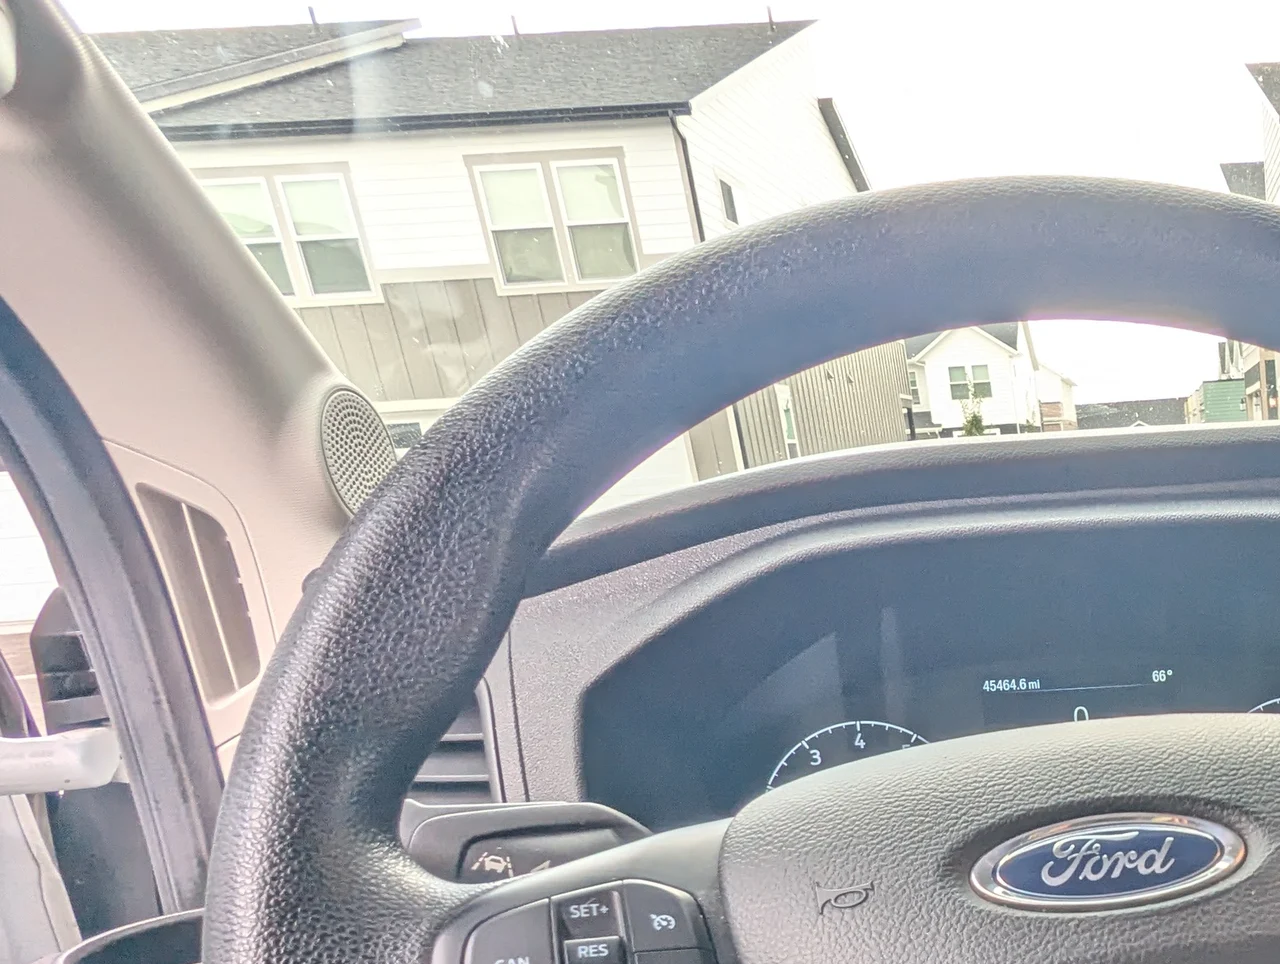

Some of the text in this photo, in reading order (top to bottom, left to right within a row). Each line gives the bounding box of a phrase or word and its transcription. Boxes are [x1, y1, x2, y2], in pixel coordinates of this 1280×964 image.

[982, 678, 1041, 692] 45464.6 mi
[854, 733, 866, 749] 4
[810, 750, 822, 766] 3
[1041, 831, 1175, 887] Ford
[577, 944, 609, 958] RES
